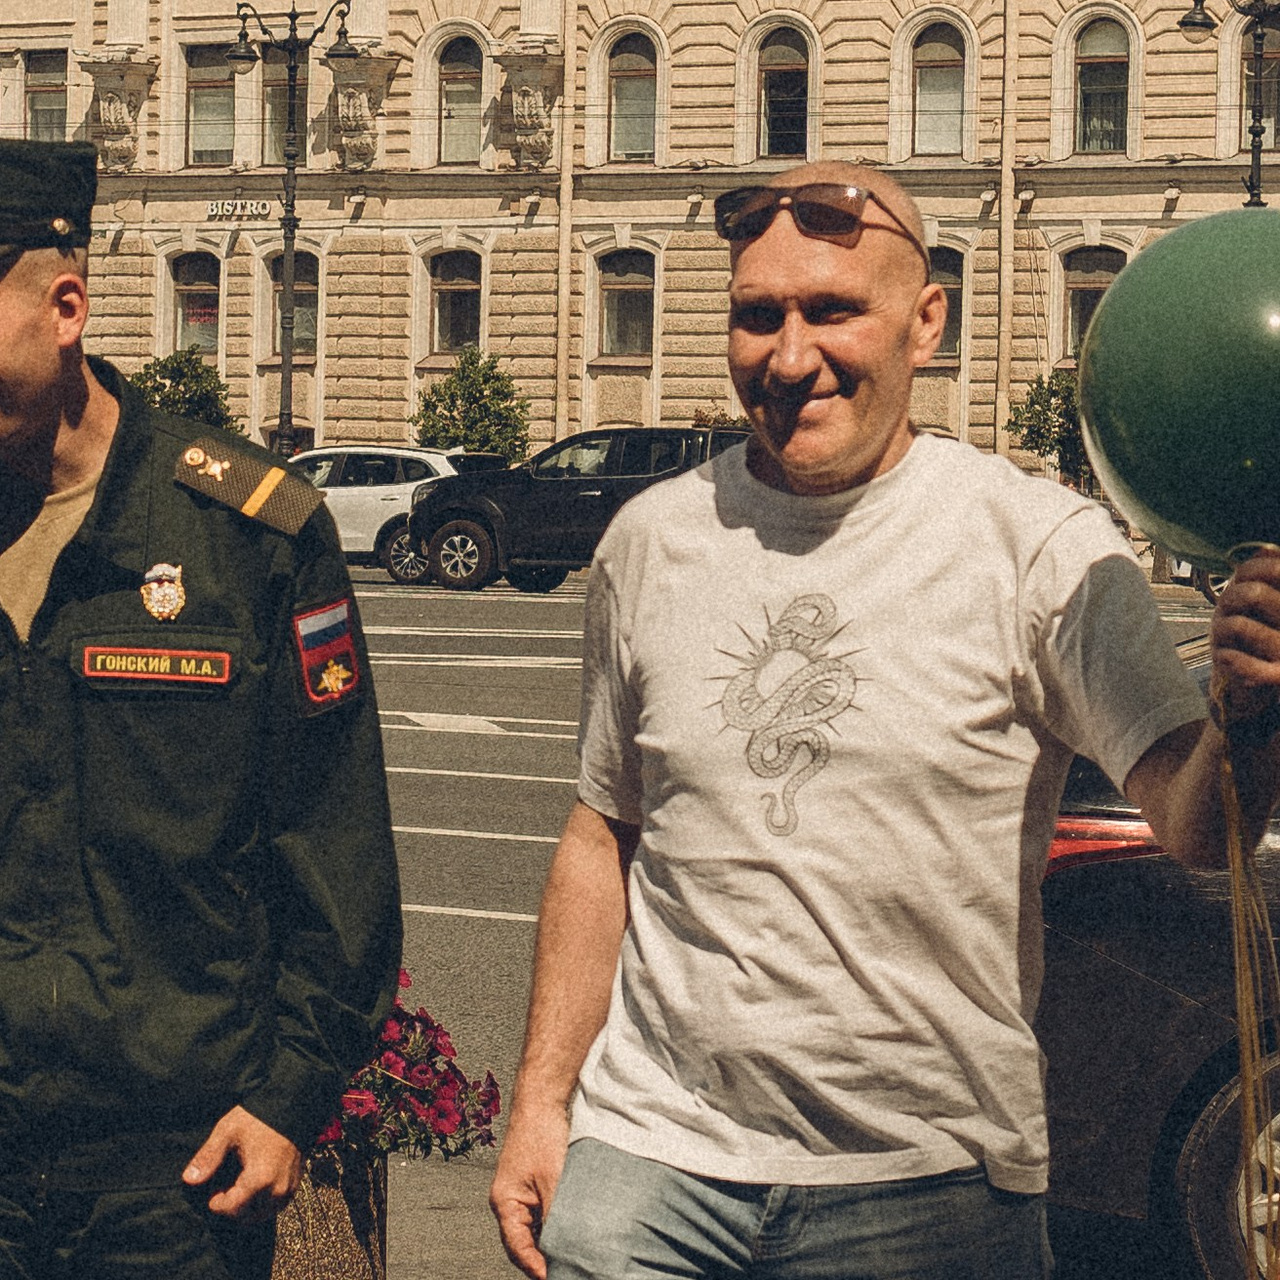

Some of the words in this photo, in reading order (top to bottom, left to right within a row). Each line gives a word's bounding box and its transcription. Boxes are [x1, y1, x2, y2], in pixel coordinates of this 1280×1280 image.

[207, 200, 272, 216] BISTRO
[96, 654, 171, 673] ГОНСКИЙ
[180, 658, 218, 676] М.А.
